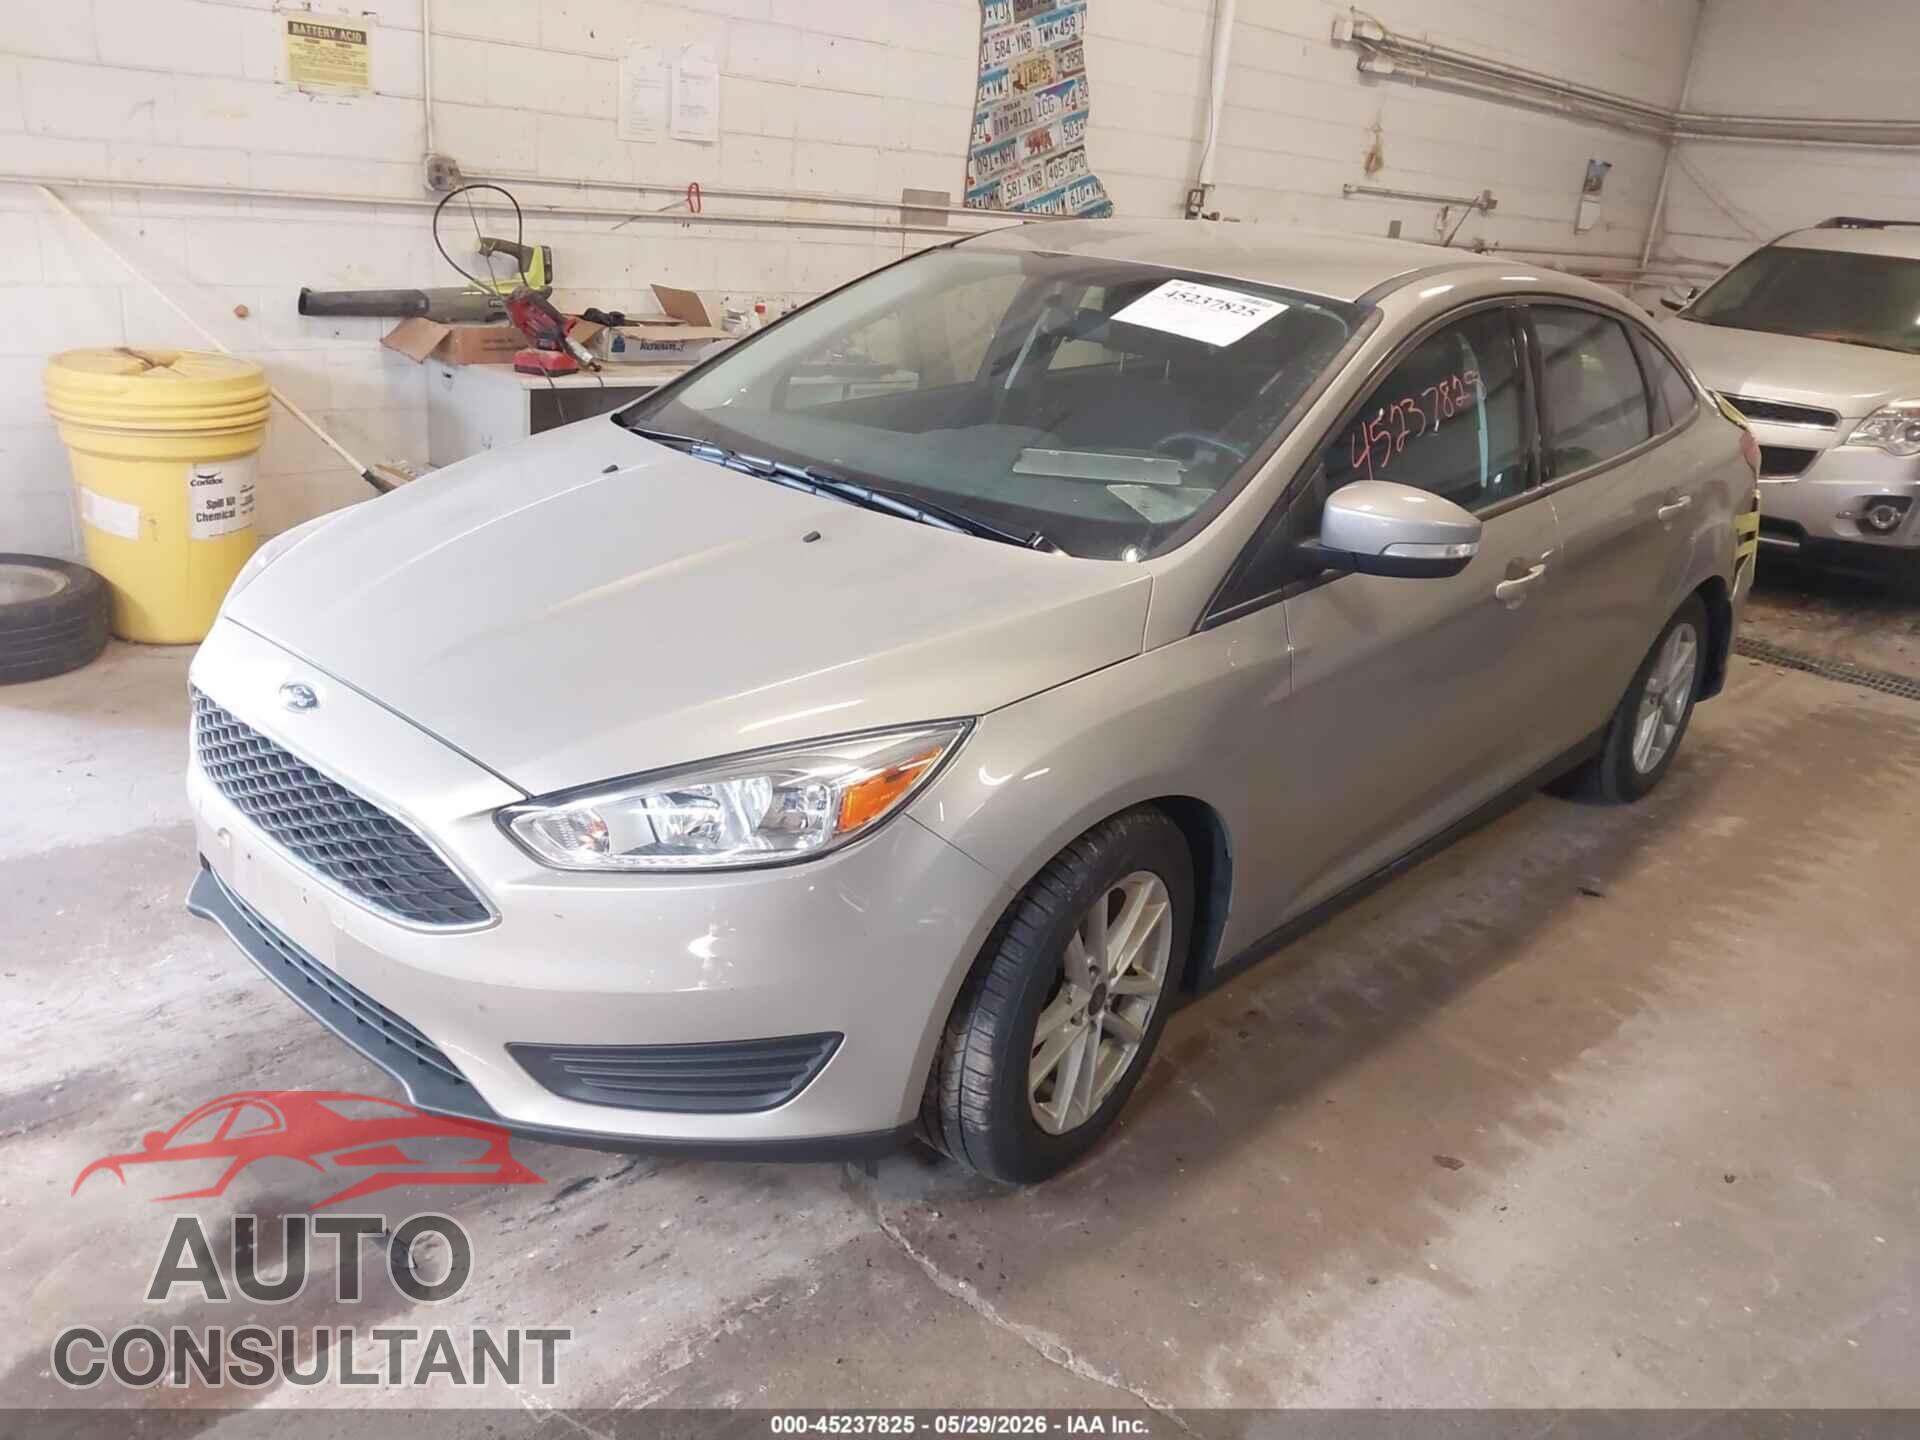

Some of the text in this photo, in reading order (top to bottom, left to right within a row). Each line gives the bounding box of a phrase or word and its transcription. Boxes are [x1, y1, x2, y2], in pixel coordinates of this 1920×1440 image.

[292, 23, 362, 41] BATTERY ACID
[1163, 289, 1261, 317] 45237825
[190, 478, 223, 487] Condor
[206, 496, 236, 510] Spill Kit
[196, 508, 236, 522] Chemical
